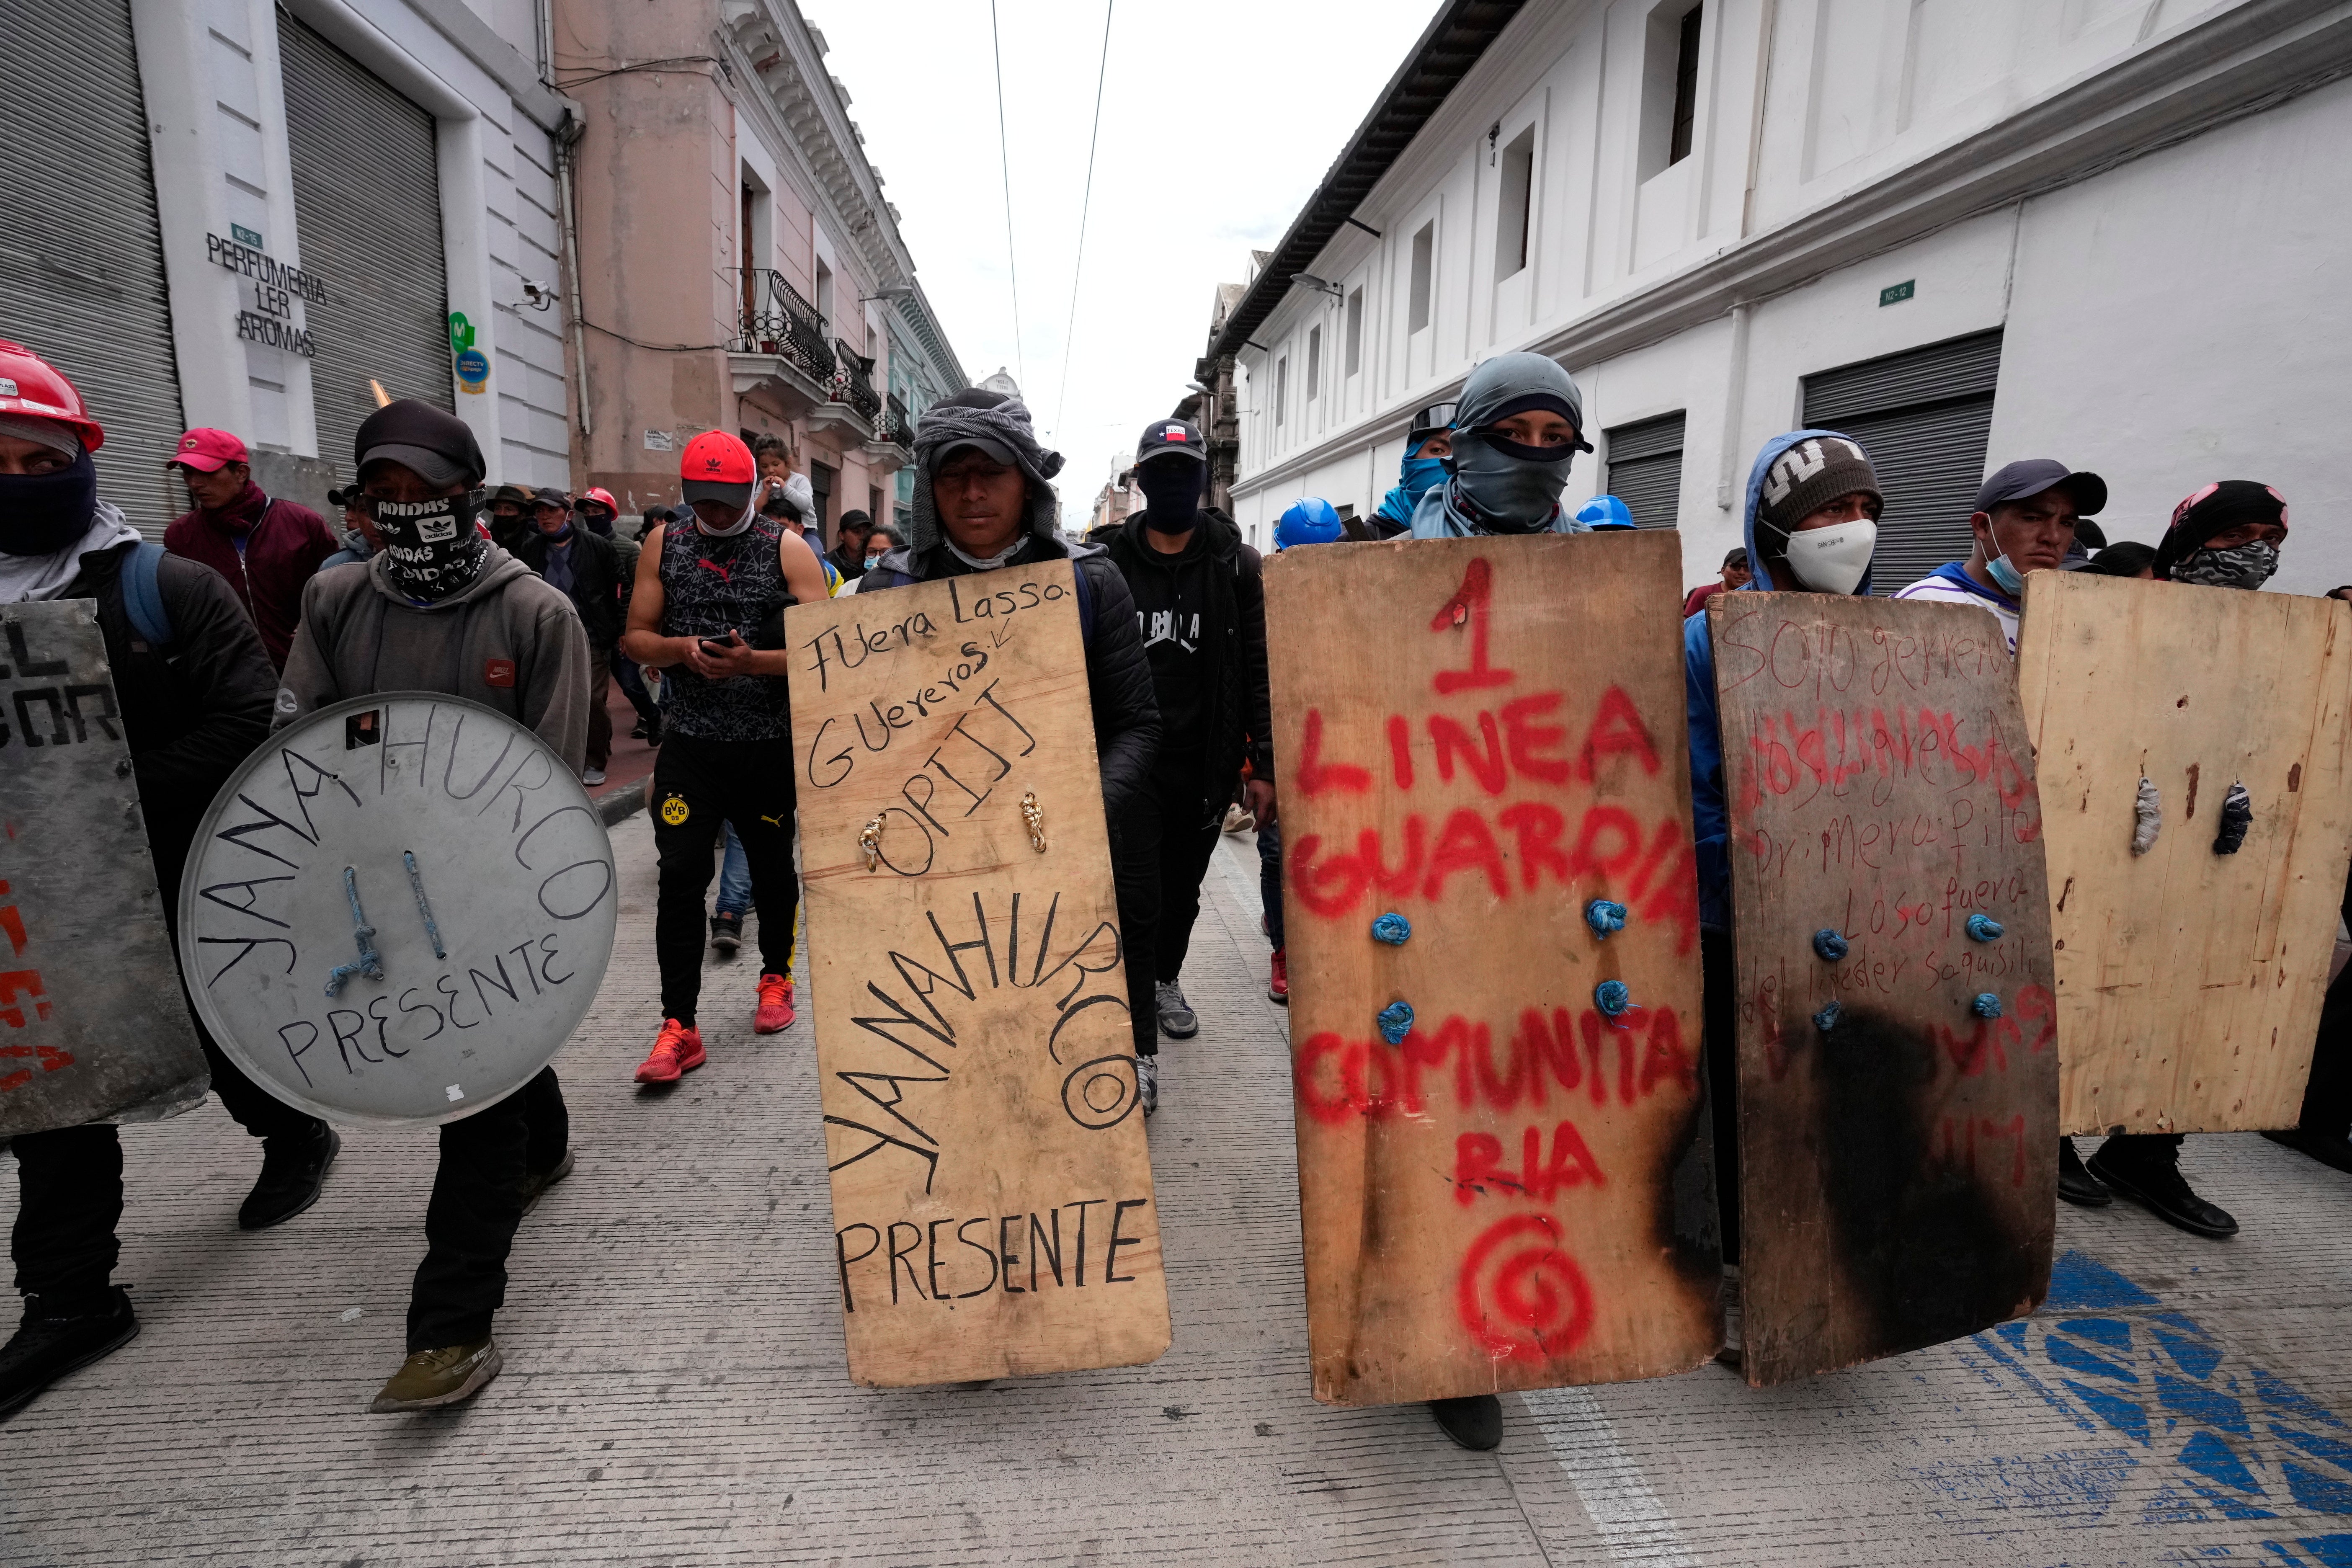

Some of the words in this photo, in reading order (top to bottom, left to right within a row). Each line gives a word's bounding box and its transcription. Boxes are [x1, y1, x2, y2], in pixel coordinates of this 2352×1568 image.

[236, 227, 258, 245] N2-15
[206, 232, 328, 306] PERFUMERIA
[255, 282, 291, 320] LER
[237, 310, 316, 357] AROMAS
[379, 498, 449, 519] ADIDAS
[389, 544, 434, 564] ADIDAS
[425, 531, 453, 539] adidas
[1818, 539, 1835, 548] EC-N95
[1430, 557, 1516, 695] 1
[1296, 685, 1661, 796] LINEA
[665, 802, 686, 815] BVB
[277, 934, 574, 1088] PRESENTE
[823, 892, 1140, 1195] YANAHURCO
[1453, 1120, 1607, 1206] RIA
[836, 1198, 1148, 1313] PRESENTE
